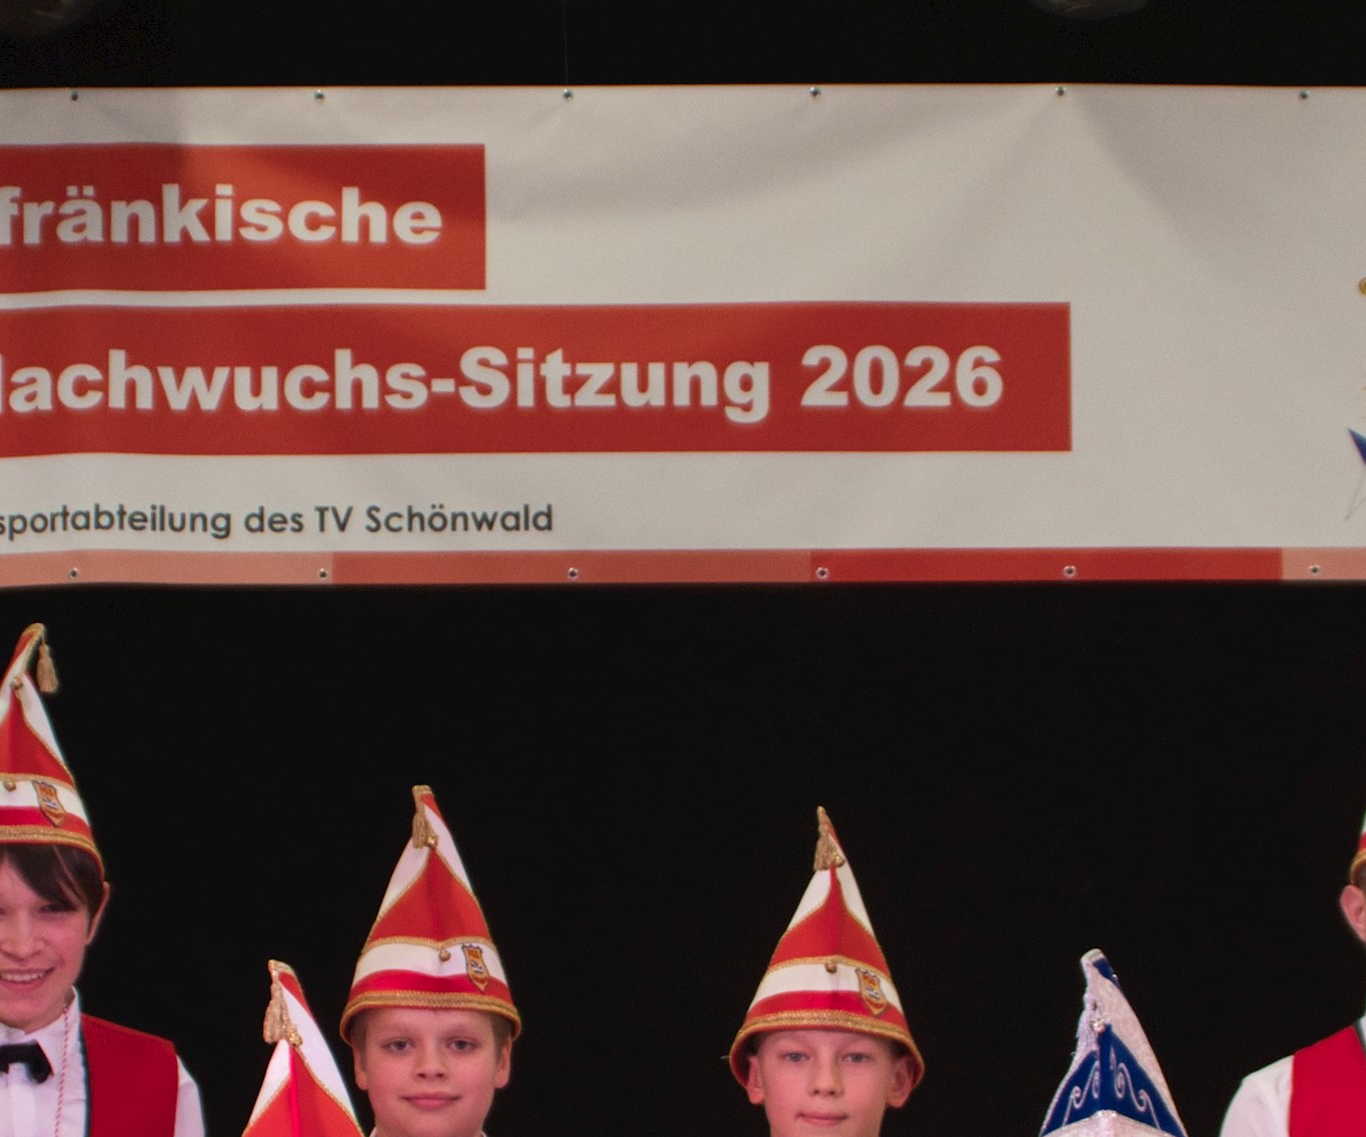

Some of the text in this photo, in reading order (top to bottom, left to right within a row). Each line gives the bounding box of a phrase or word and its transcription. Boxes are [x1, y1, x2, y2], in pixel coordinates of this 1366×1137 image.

[799, 343, 1005, 410] 2026
[243, 505, 305, 535] des
[314, 505, 354, 534] TV
[364, 502, 554, 534] Schönwald
